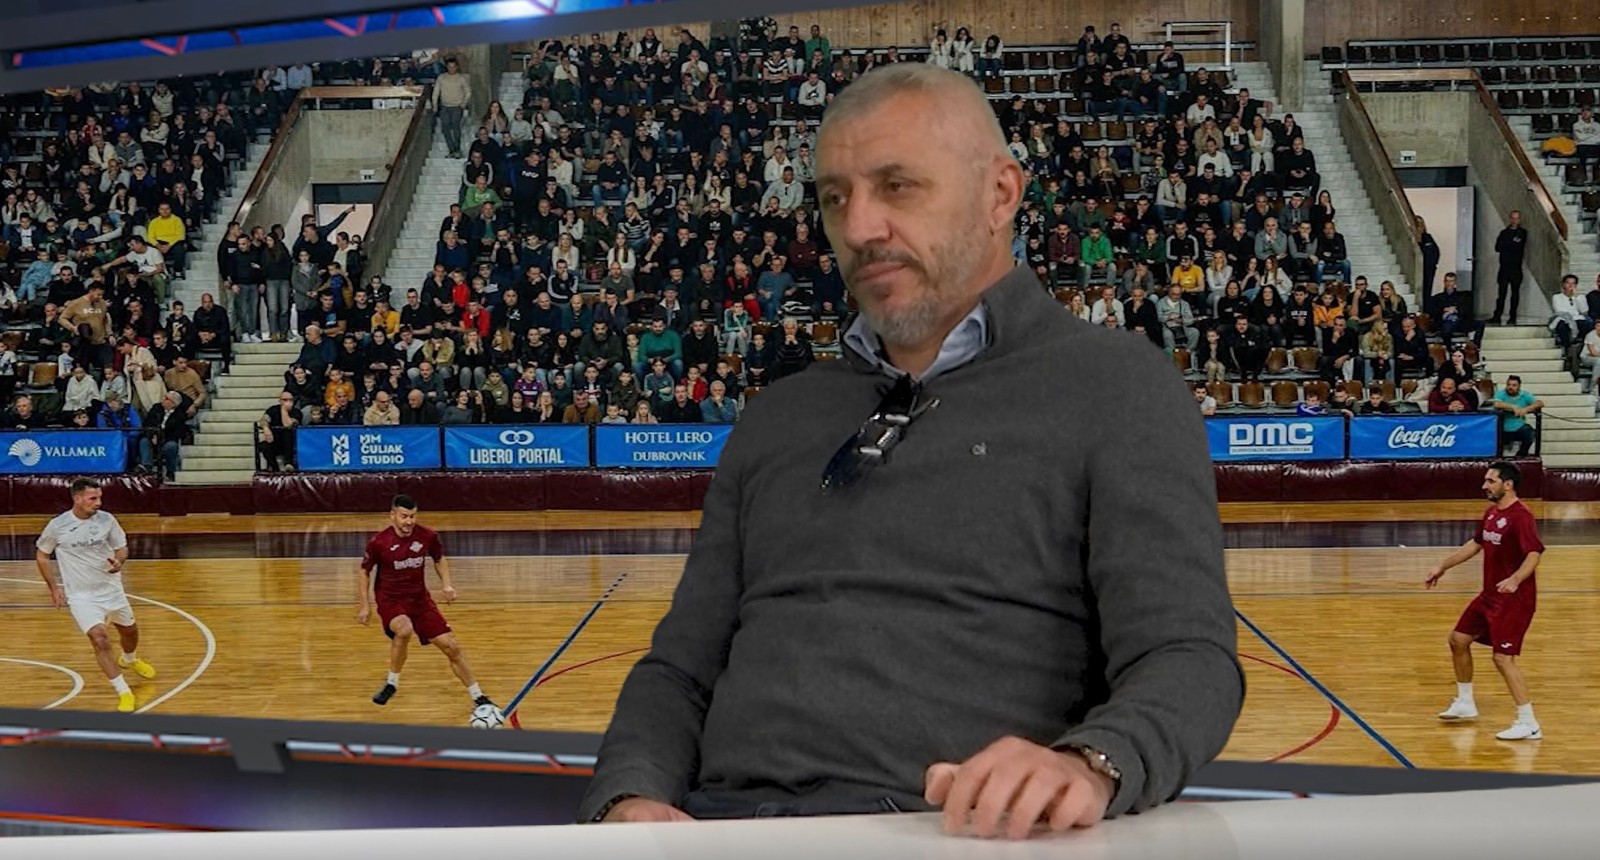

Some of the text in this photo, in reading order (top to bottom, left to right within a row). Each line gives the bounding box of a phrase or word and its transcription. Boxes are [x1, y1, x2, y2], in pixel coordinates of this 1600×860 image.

[625, 431, 713, 444] HOTEL LERO
[1229, 423, 1314, 445] DMC
[1388, 424, 1458, 449] Coca-Cola
[45, 446, 107, 458] VALAMAR
[470, 448, 564, 465] LIBERO PORTAL
[632, 451, 706, 462] DUBROVNIK
[360, 454, 405, 465] STUDIO
